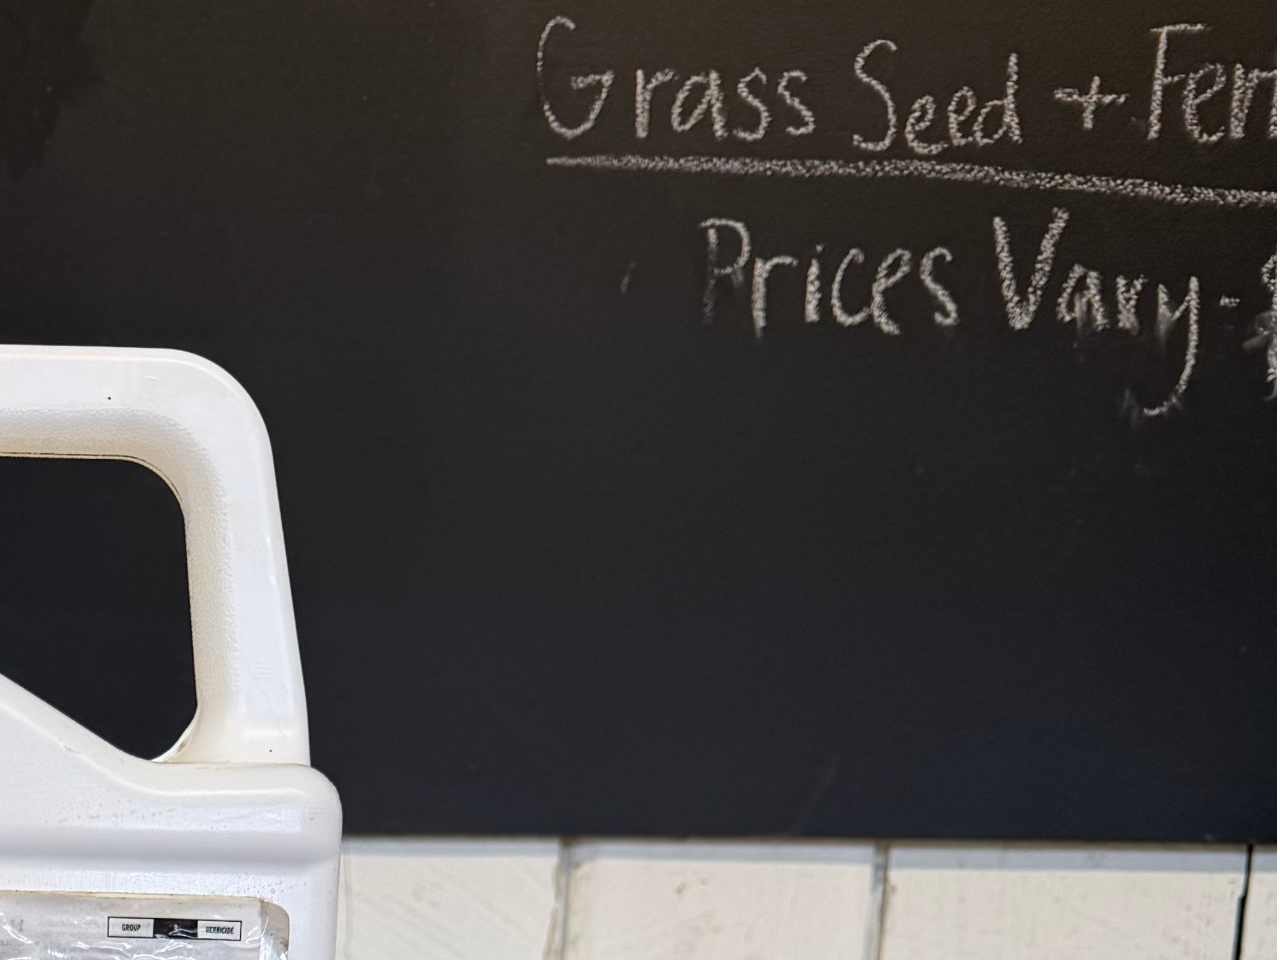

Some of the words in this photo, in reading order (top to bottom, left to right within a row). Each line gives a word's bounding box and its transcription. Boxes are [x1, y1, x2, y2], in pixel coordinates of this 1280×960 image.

[537, 16, 816, 142] Grass
[852, 39, 1022, 156] Seed
[699, 217, 960, 340] Prices
[121, 924, 141, 932] GROUP
